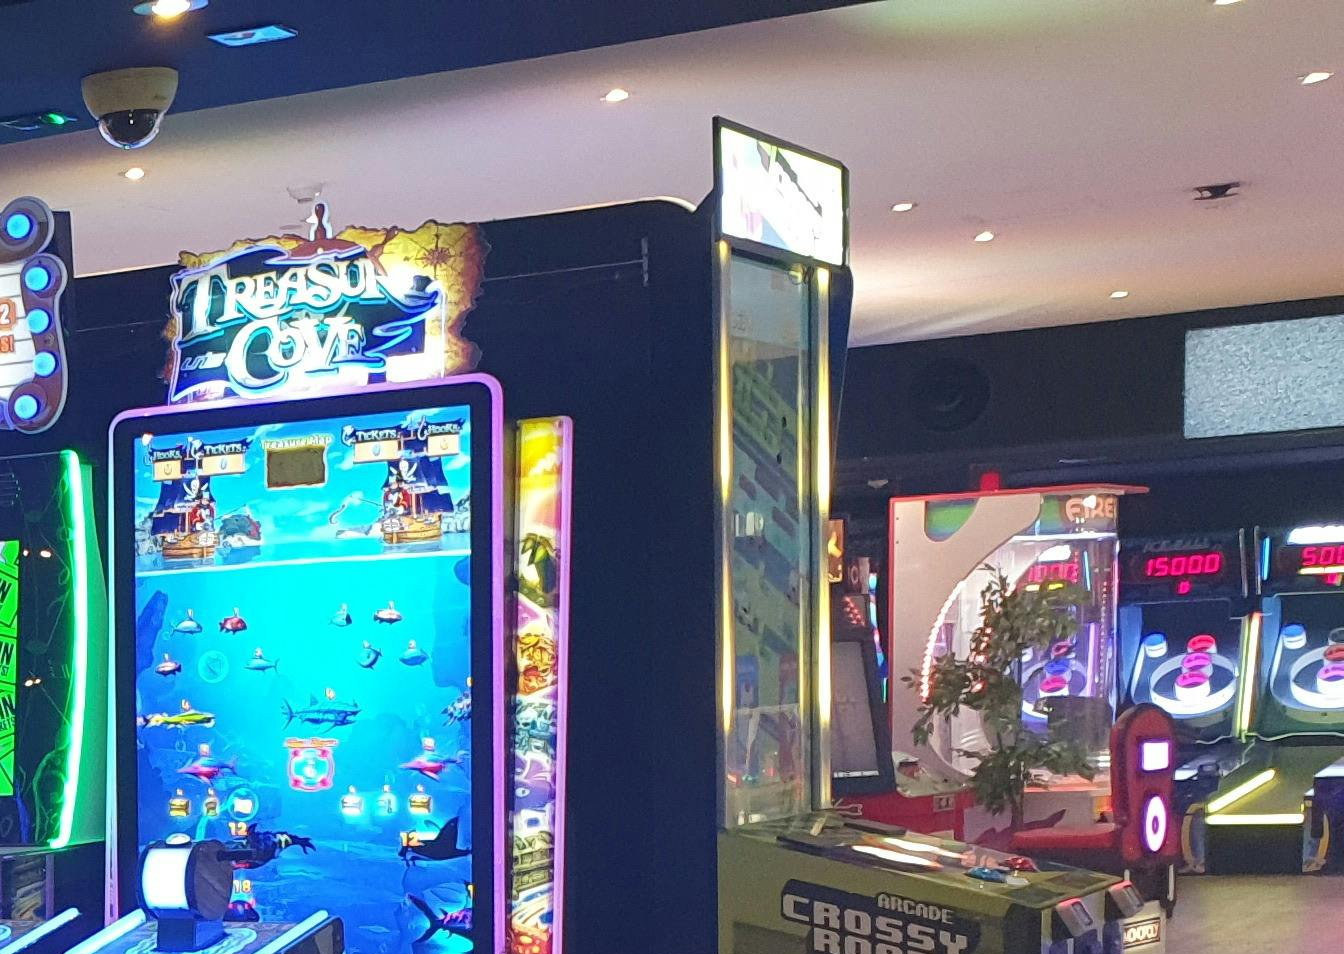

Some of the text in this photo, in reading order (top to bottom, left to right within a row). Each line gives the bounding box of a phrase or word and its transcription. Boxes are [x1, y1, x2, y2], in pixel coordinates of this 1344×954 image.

[224, 315, 368, 388] COVE
[1146, 553, 1222, 577] 15000
[228, 821, 248, 837] 12
[399, 830, 421, 847] 12
[233, 879, 253, 894] 18
[877, 893, 955, 925] ARCADE
